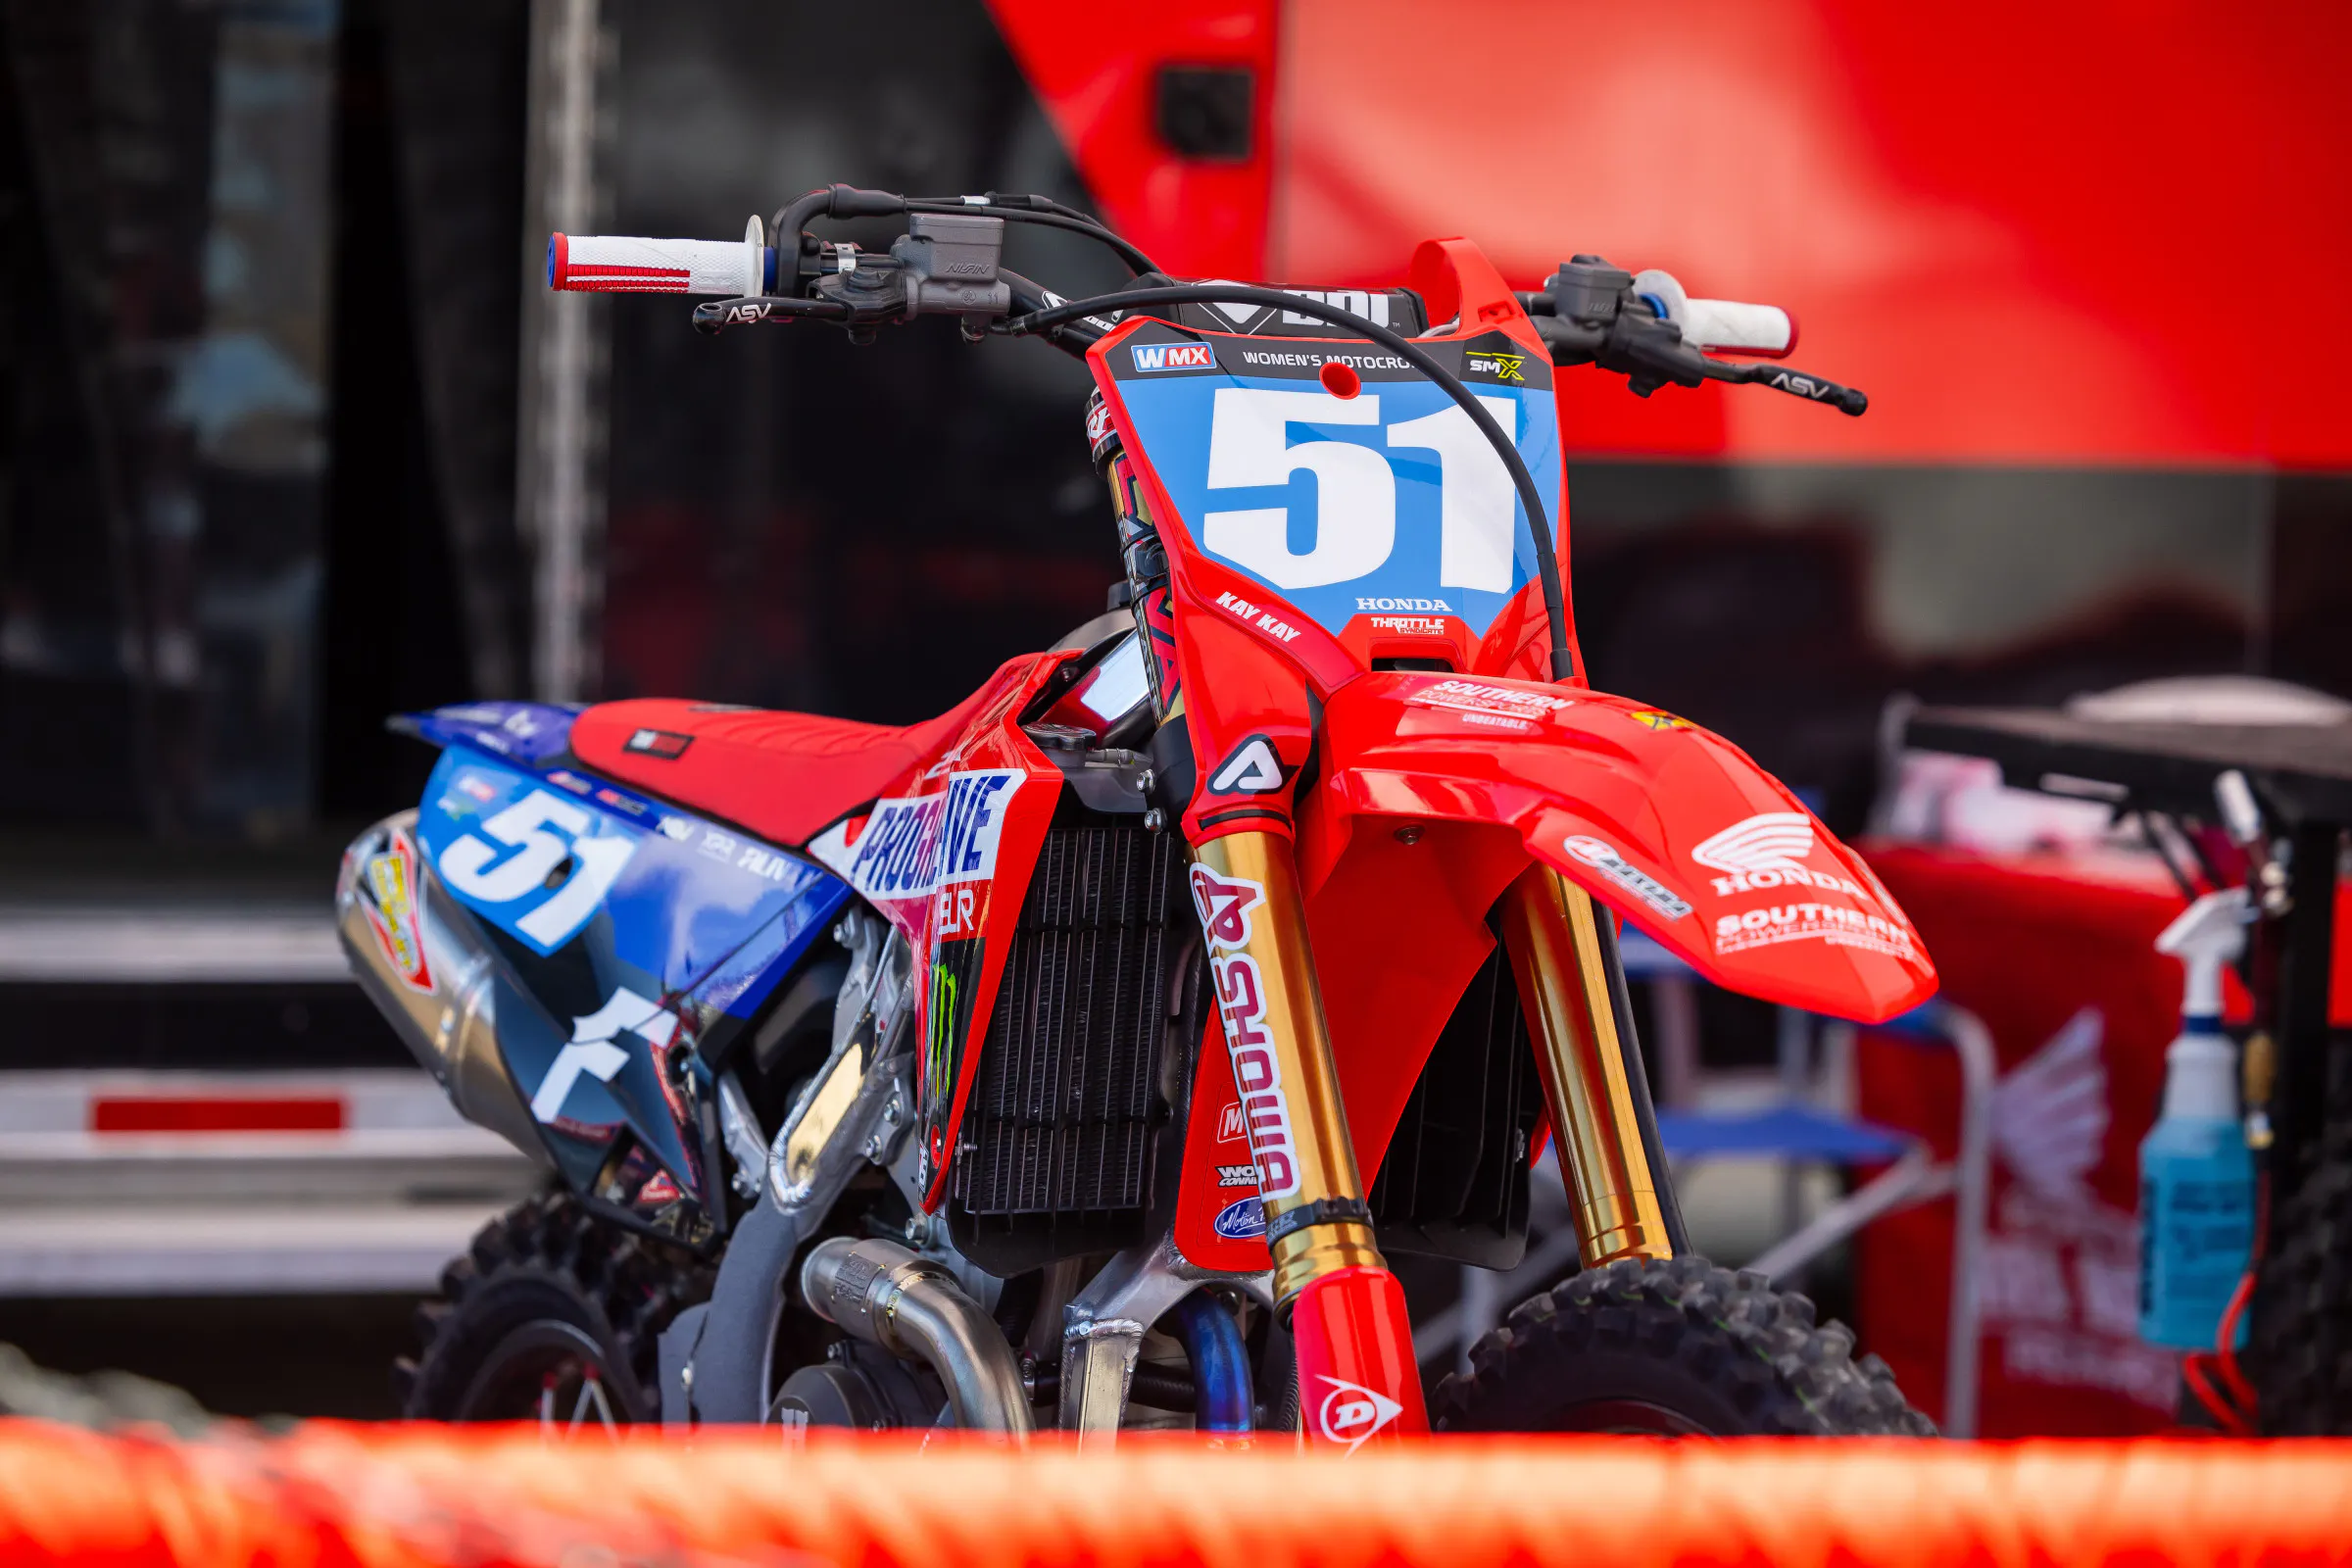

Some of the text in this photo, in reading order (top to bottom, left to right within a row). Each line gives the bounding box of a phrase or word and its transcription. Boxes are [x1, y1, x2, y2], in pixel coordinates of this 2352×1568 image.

[725, 303, 771, 323] ASV
[1136, 346, 1212, 368] WMX
[1243, 351, 1322, 367] WOMEN'S
[1469, 357, 1526, 381] SMX
[1771, 372, 1830, 400] ASV
[1202, 387, 1517, 595] 51
[1215, 590, 1301, 643] KAY KAY
[1354, 597, 1452, 612] HONDA
[1370, 616, 1446, 630] THROTTLE
[1434, 680, 1575, 710] SOUTHERN
[437, 788, 636, 949] 51
[1709, 868, 1871, 901] HONDA
[1715, 903, 1911, 944] SOUTHERN
[1214, 959, 1294, 1194] SHOWA
